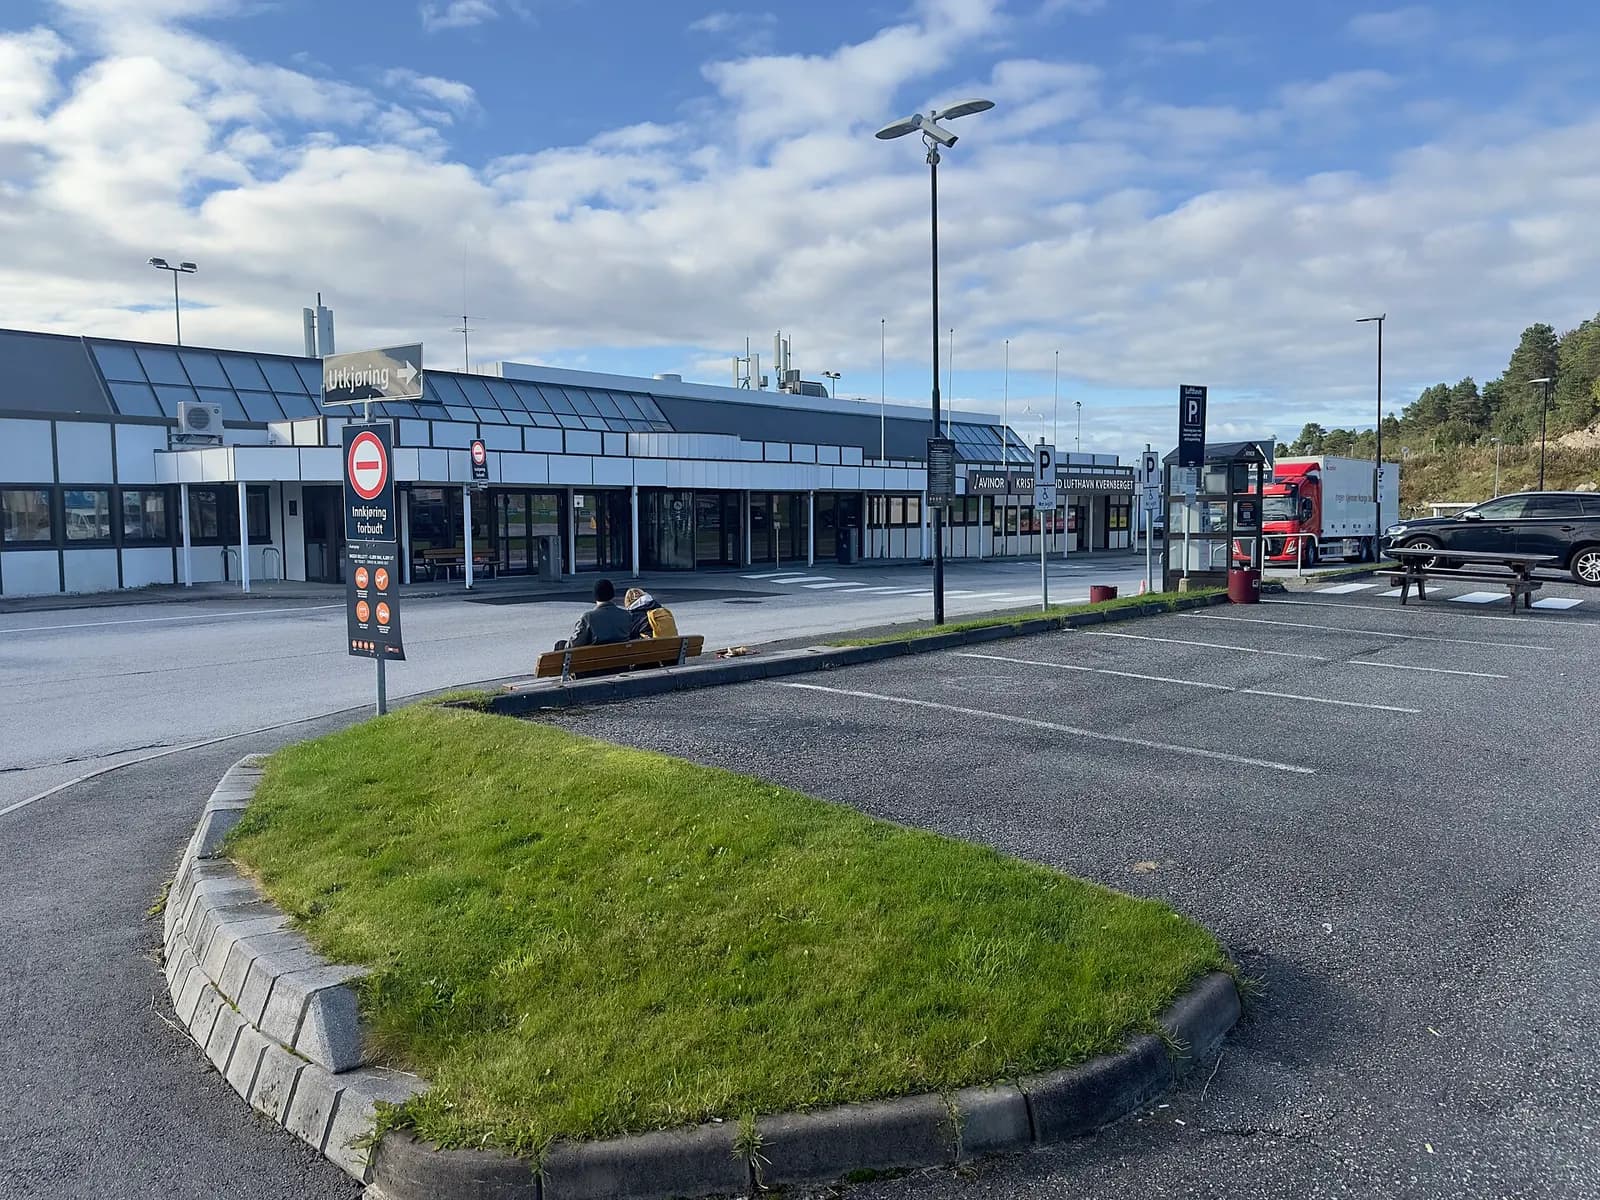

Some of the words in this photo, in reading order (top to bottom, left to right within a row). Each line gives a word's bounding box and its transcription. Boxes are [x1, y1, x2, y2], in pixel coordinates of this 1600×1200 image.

[328, 364, 389, 393] Utkjøring
[1189, 400, 1198, 423] P
[1040, 450, 1050, 480] P
[1147, 457, 1154, 483] P
[978, 477, 1005, 489] AVINOR
[1063, 479, 1095, 489] LUFTHAVN
[1095, 480, 1134, 490] KVERNBERGET
[352, 505, 387, 521] Innkjøring
[357, 521, 383, 535] forbudt
